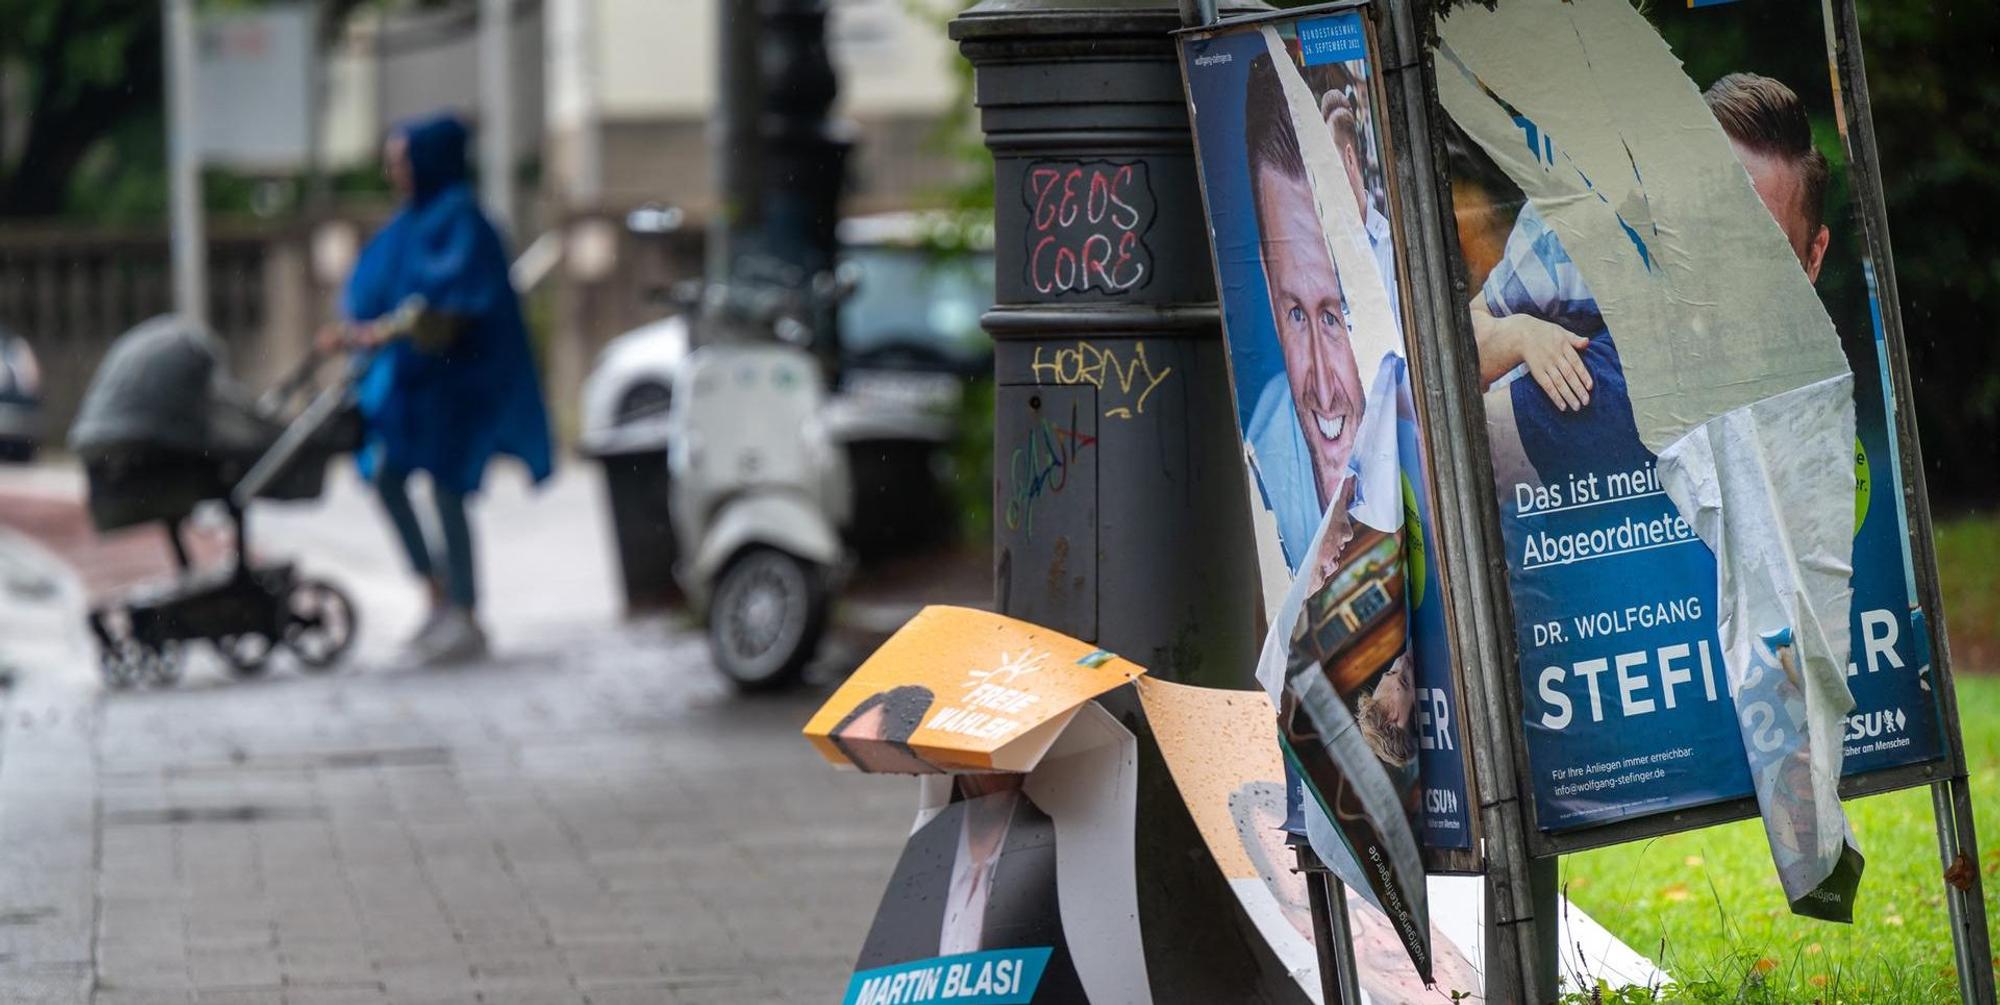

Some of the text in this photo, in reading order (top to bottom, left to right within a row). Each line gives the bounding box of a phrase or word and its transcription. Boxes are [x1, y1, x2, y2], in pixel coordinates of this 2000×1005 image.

[1032, 231, 1144, 293] CORE
[1031, 341, 1172, 414] HORNY
[1515, 481, 1562, 513] Das
[1568, 472, 1600, 503] ist
[1533, 597, 1702, 647] DR. WOLFGANG
[960, 683, 1041, 714] FREIE
[1862, 744, 1874, 753] am
[1874, 737, 1911, 751] Menschen
[1552, 769, 1567, 781] Für
[1568, 766, 1584, 777] Ihre
[1585, 760, 1622, 775] Anliegen
[1622, 754, 1650, 767] immer
[1554, 767, 1666, 797] info@wolfgang-stefinger.de
[1426, 788, 1447, 814] CSU
[855, 959, 1023, 1005] MARTIN BLASI
